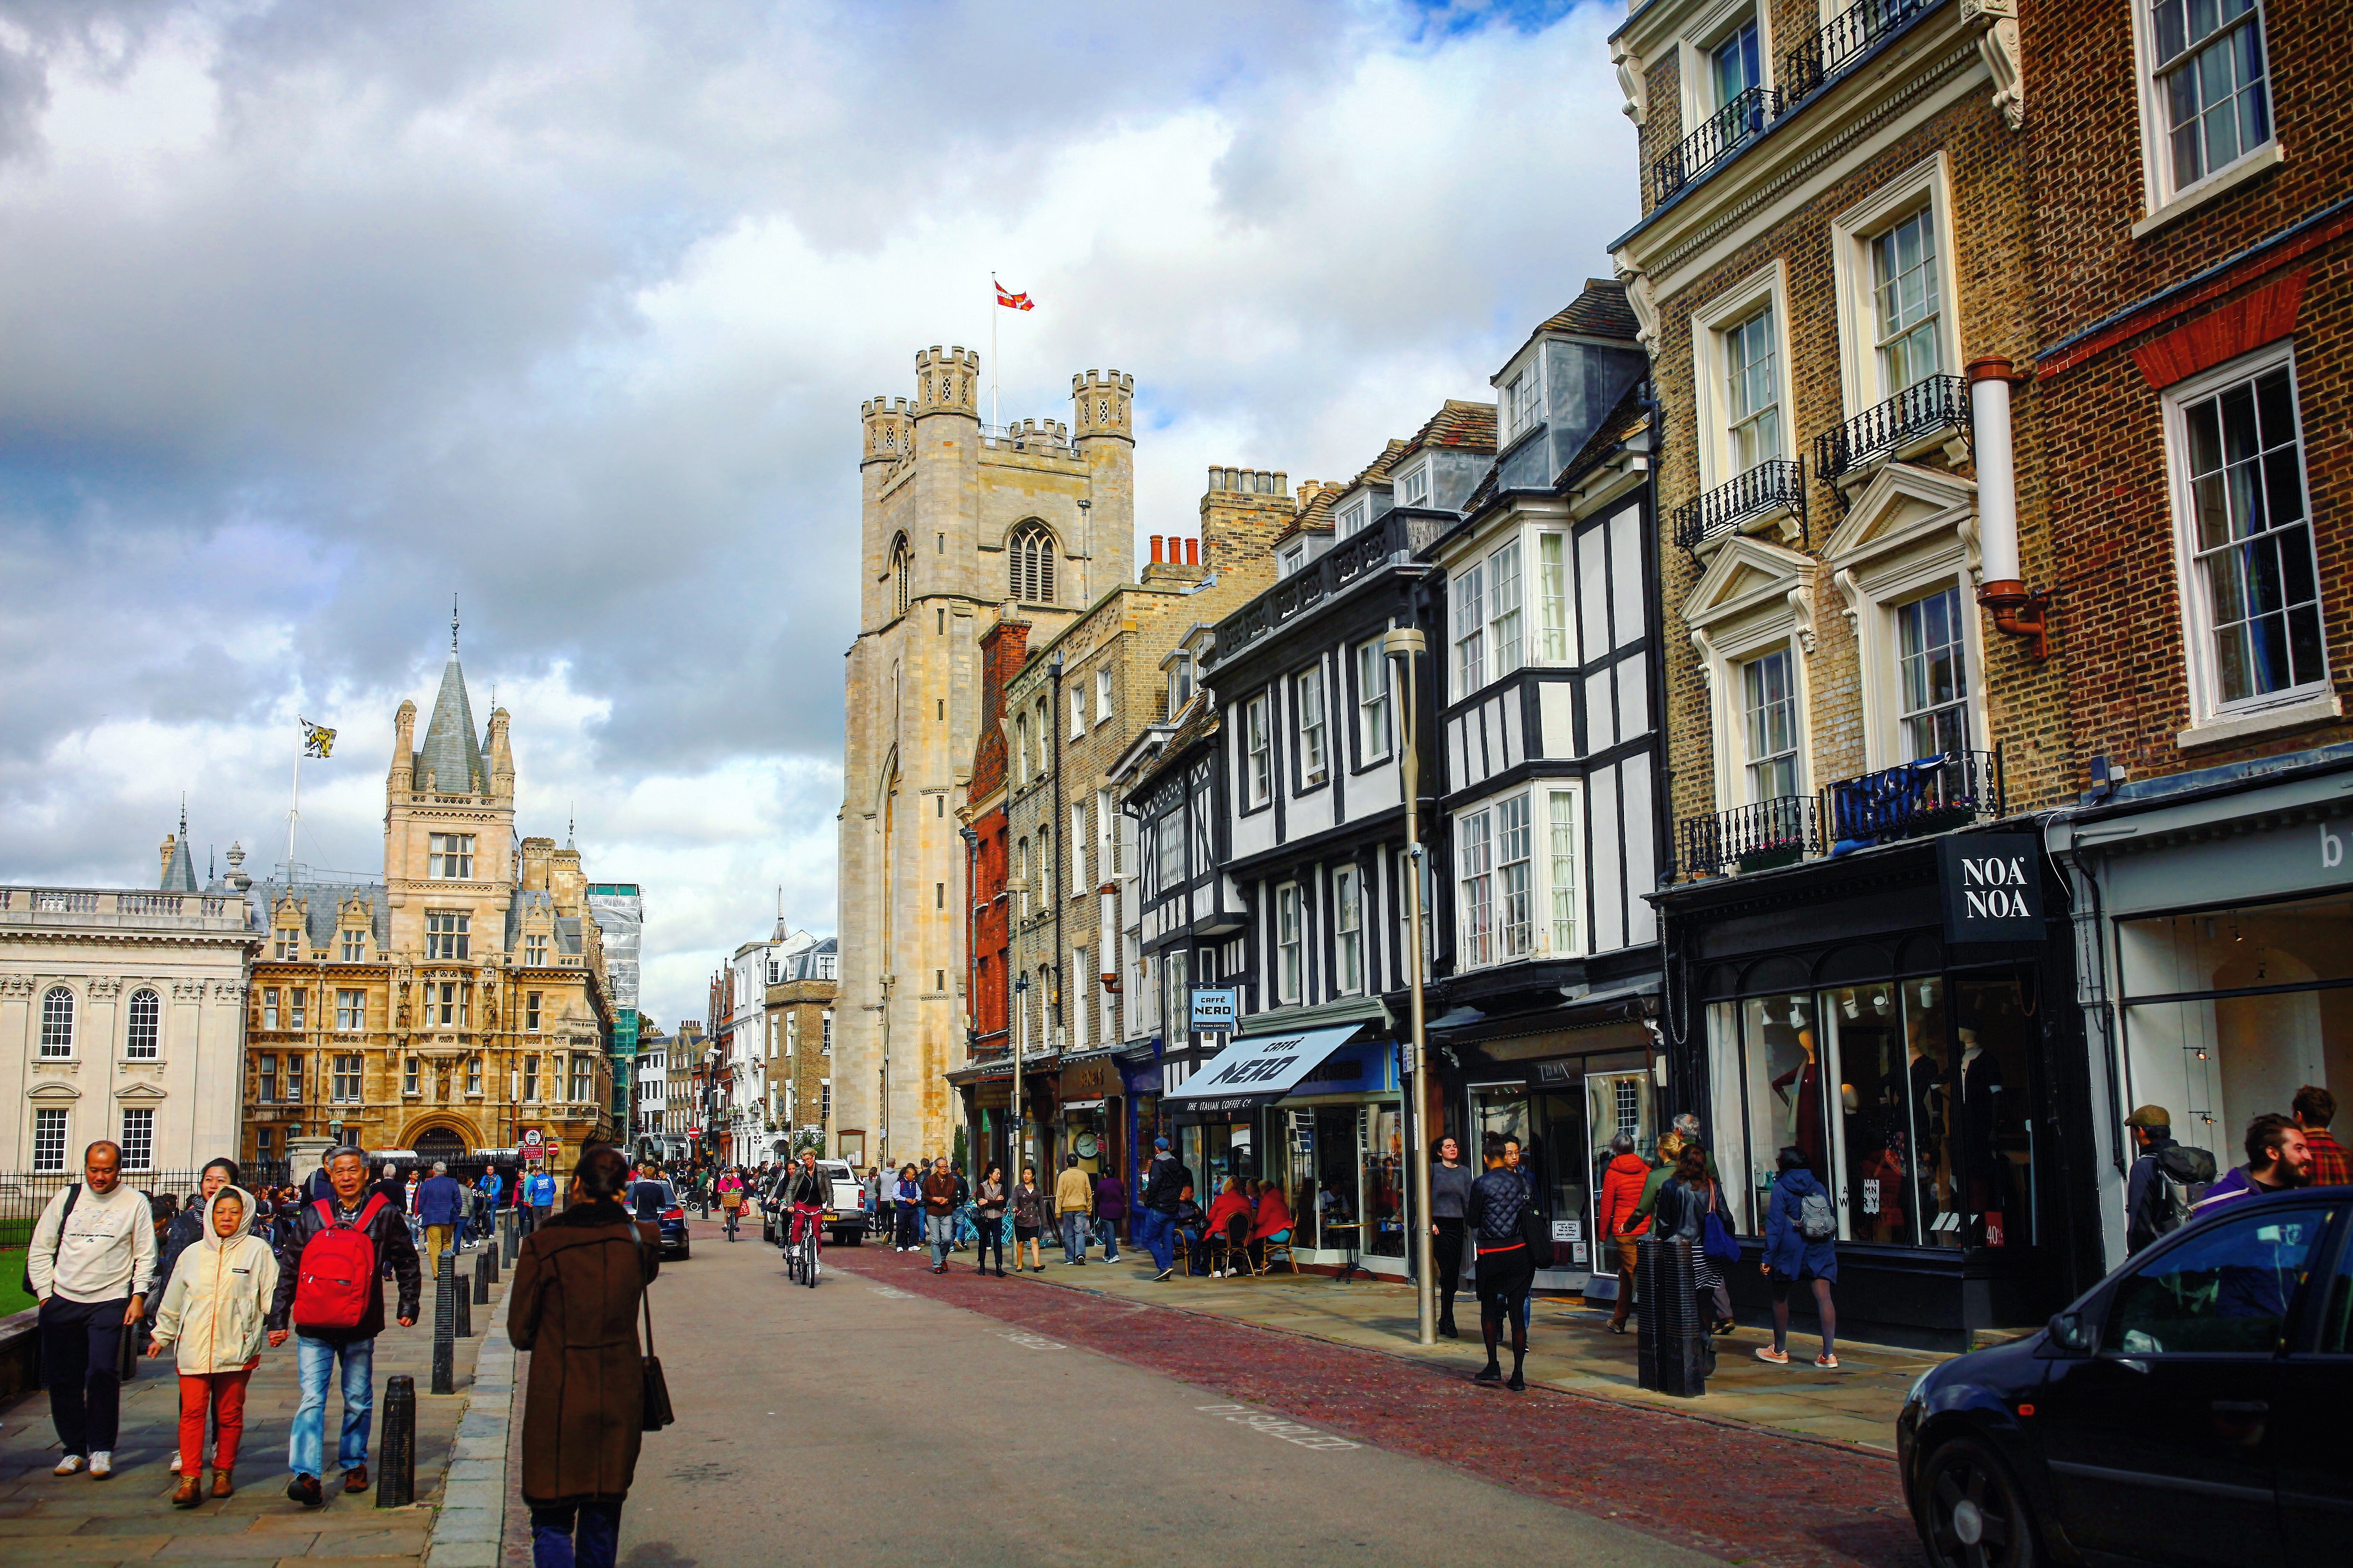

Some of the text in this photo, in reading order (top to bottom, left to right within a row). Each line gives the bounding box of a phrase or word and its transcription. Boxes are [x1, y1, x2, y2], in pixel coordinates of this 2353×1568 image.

[1961, 857, 2027, 886] NOA
[1964, 889, 2031, 918] NOA
[1195, 1006, 1231, 1015] NERO
[1208, 1055, 1300, 1085] NERO
[1538, 1063, 1569, 1081] TROON
[1187, 1102, 1197, 1111] THE
[1199, 1101, 1219, 1111] ITALIAN
[1221, 1099, 1241, 1110] COFFEE
[1843, 1186, 1877, 1194] AMN
[1839, 1198, 1868, 1207] WR
[1195, 1405, 1362, 1450] DISABLED
